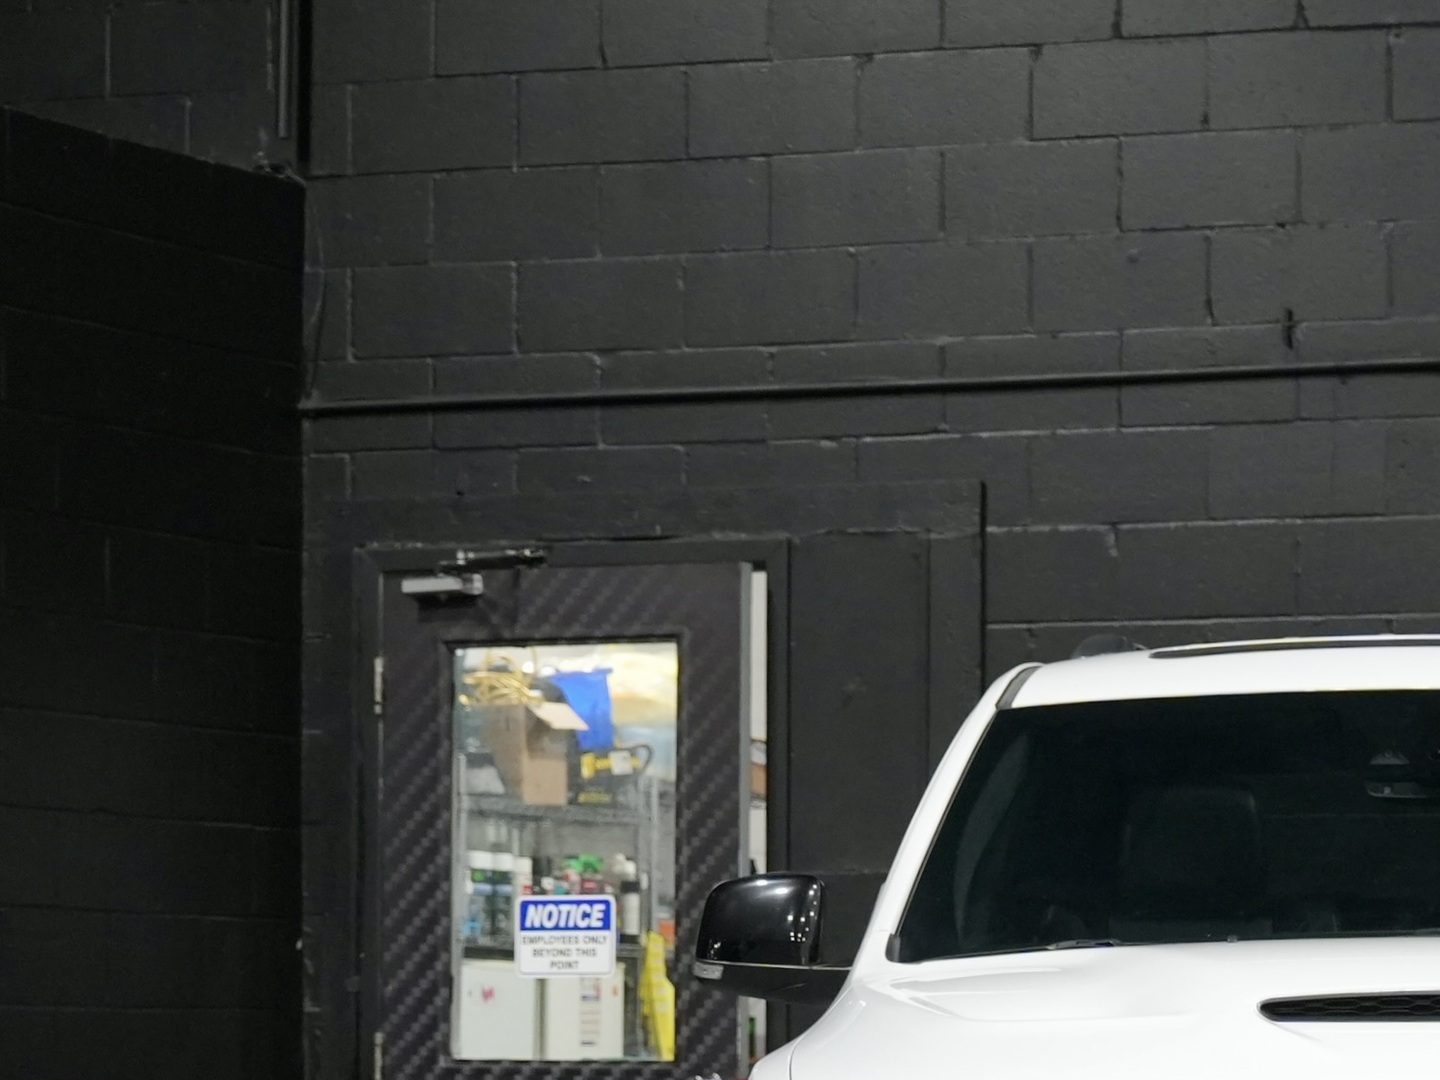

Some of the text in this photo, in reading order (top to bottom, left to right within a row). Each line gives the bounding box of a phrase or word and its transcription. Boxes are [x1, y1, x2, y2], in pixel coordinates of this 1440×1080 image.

[524, 903, 606, 929] NOTICE
[522, 935, 607, 946] EMPLOYEES ONLY
[532, 948, 597, 958] BEYOND THIS
[550, 960, 579, 970] POINT
